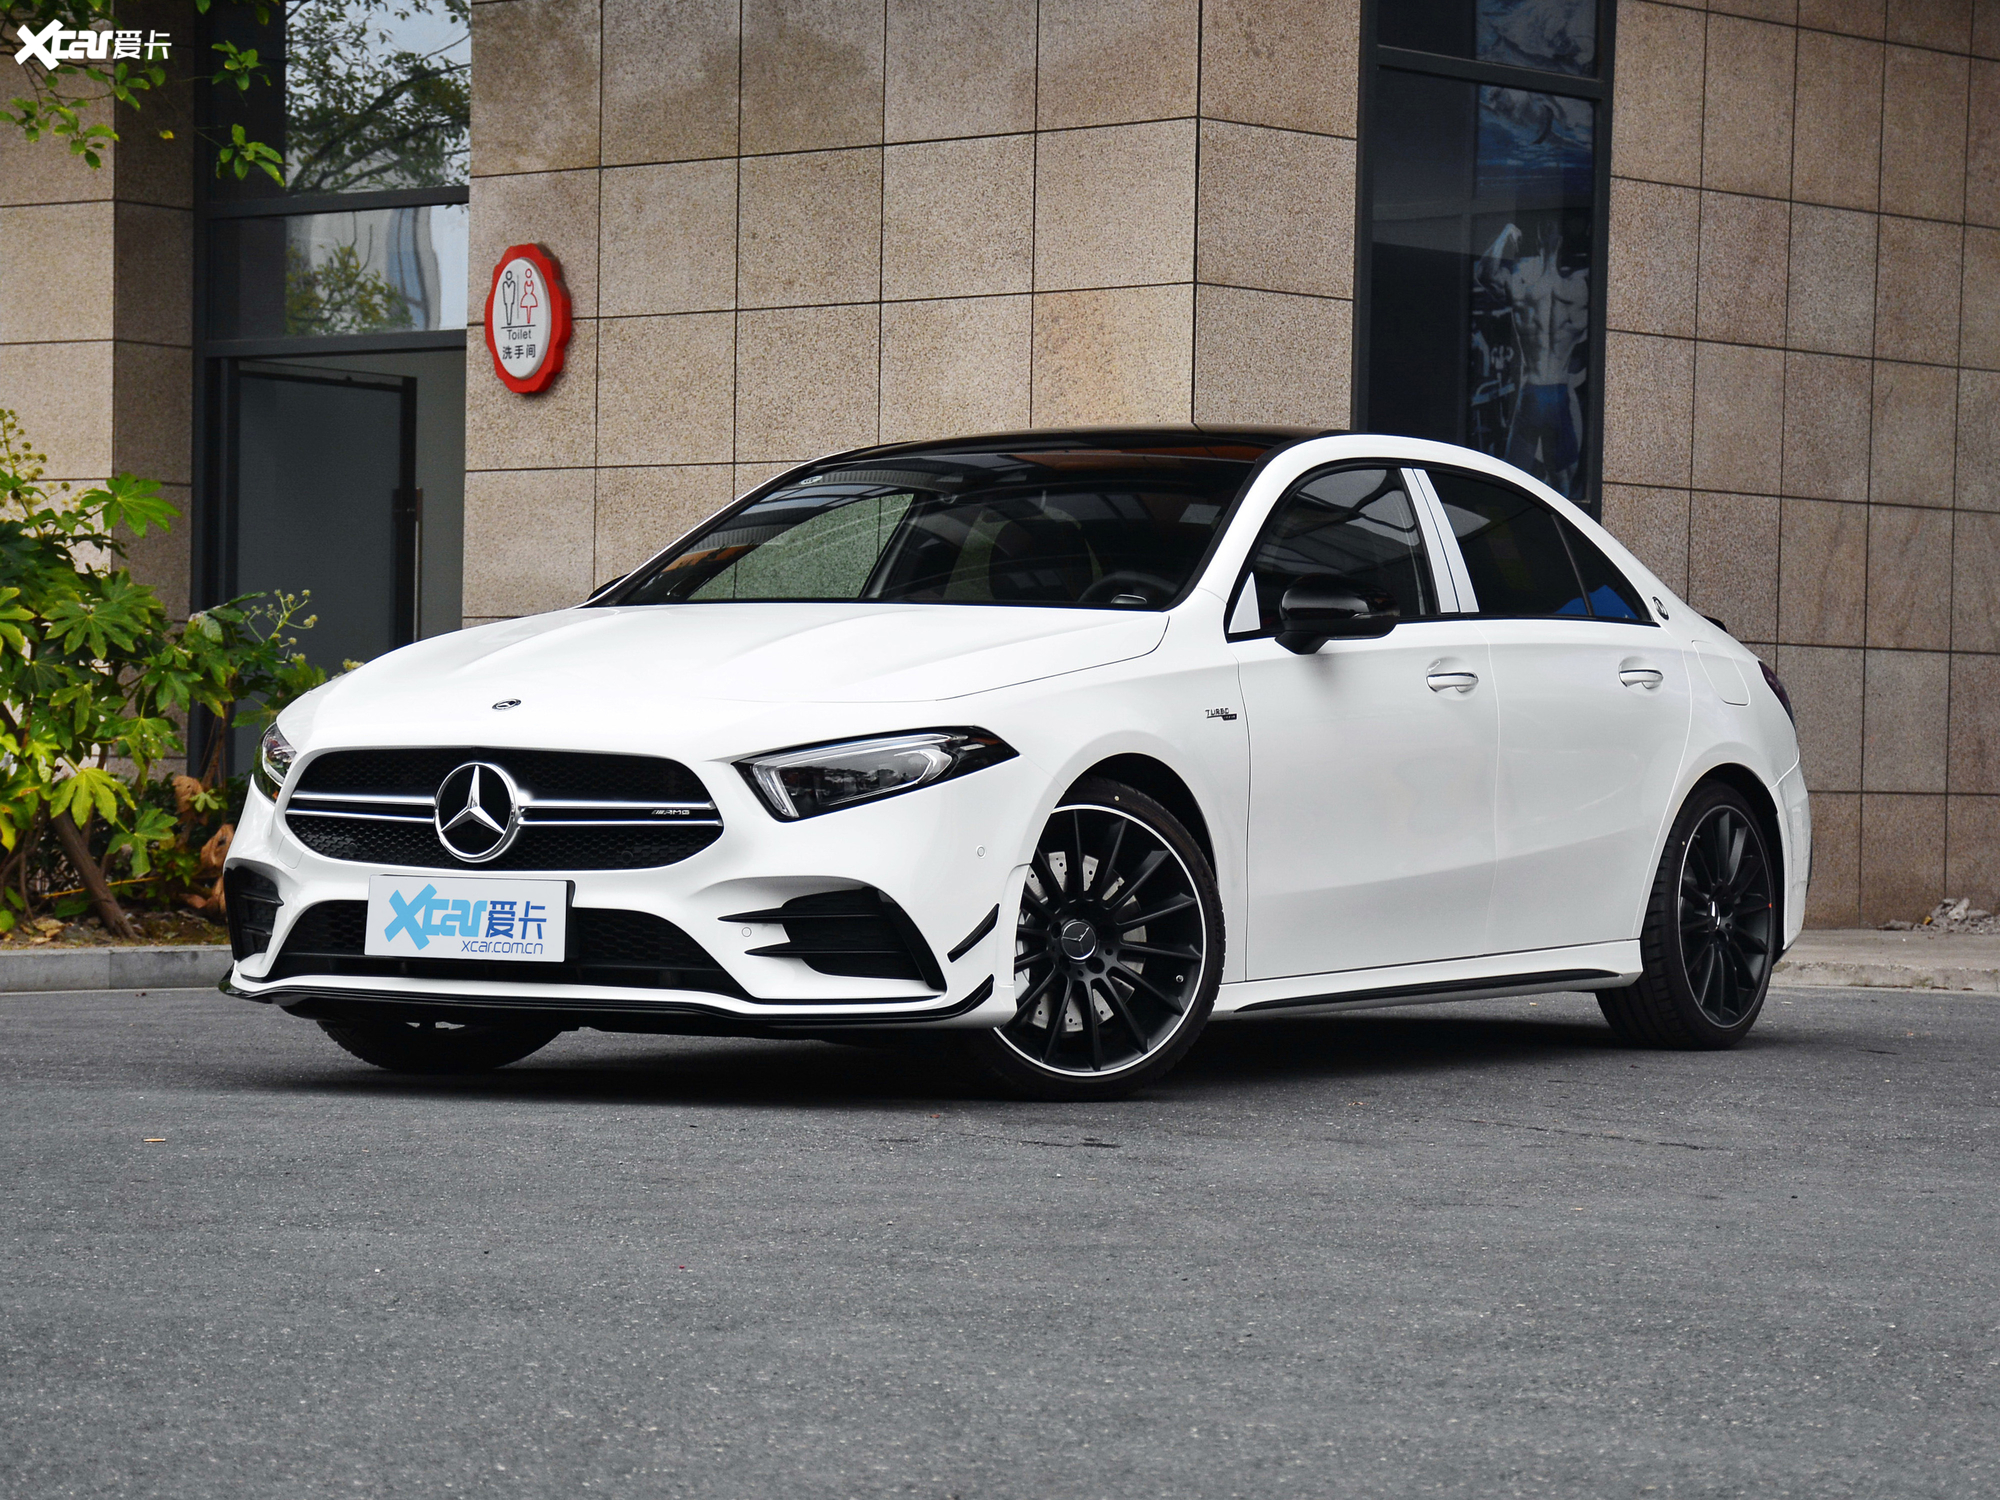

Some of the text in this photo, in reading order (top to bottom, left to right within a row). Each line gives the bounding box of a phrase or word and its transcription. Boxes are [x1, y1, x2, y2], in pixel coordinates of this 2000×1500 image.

[507, 329, 532, 341] Toilet
[502, 344, 536, 360] 洗手间
[1205, 707, 1230, 715] TURBO
[461, 940, 543, 955] xcar.com.cn
